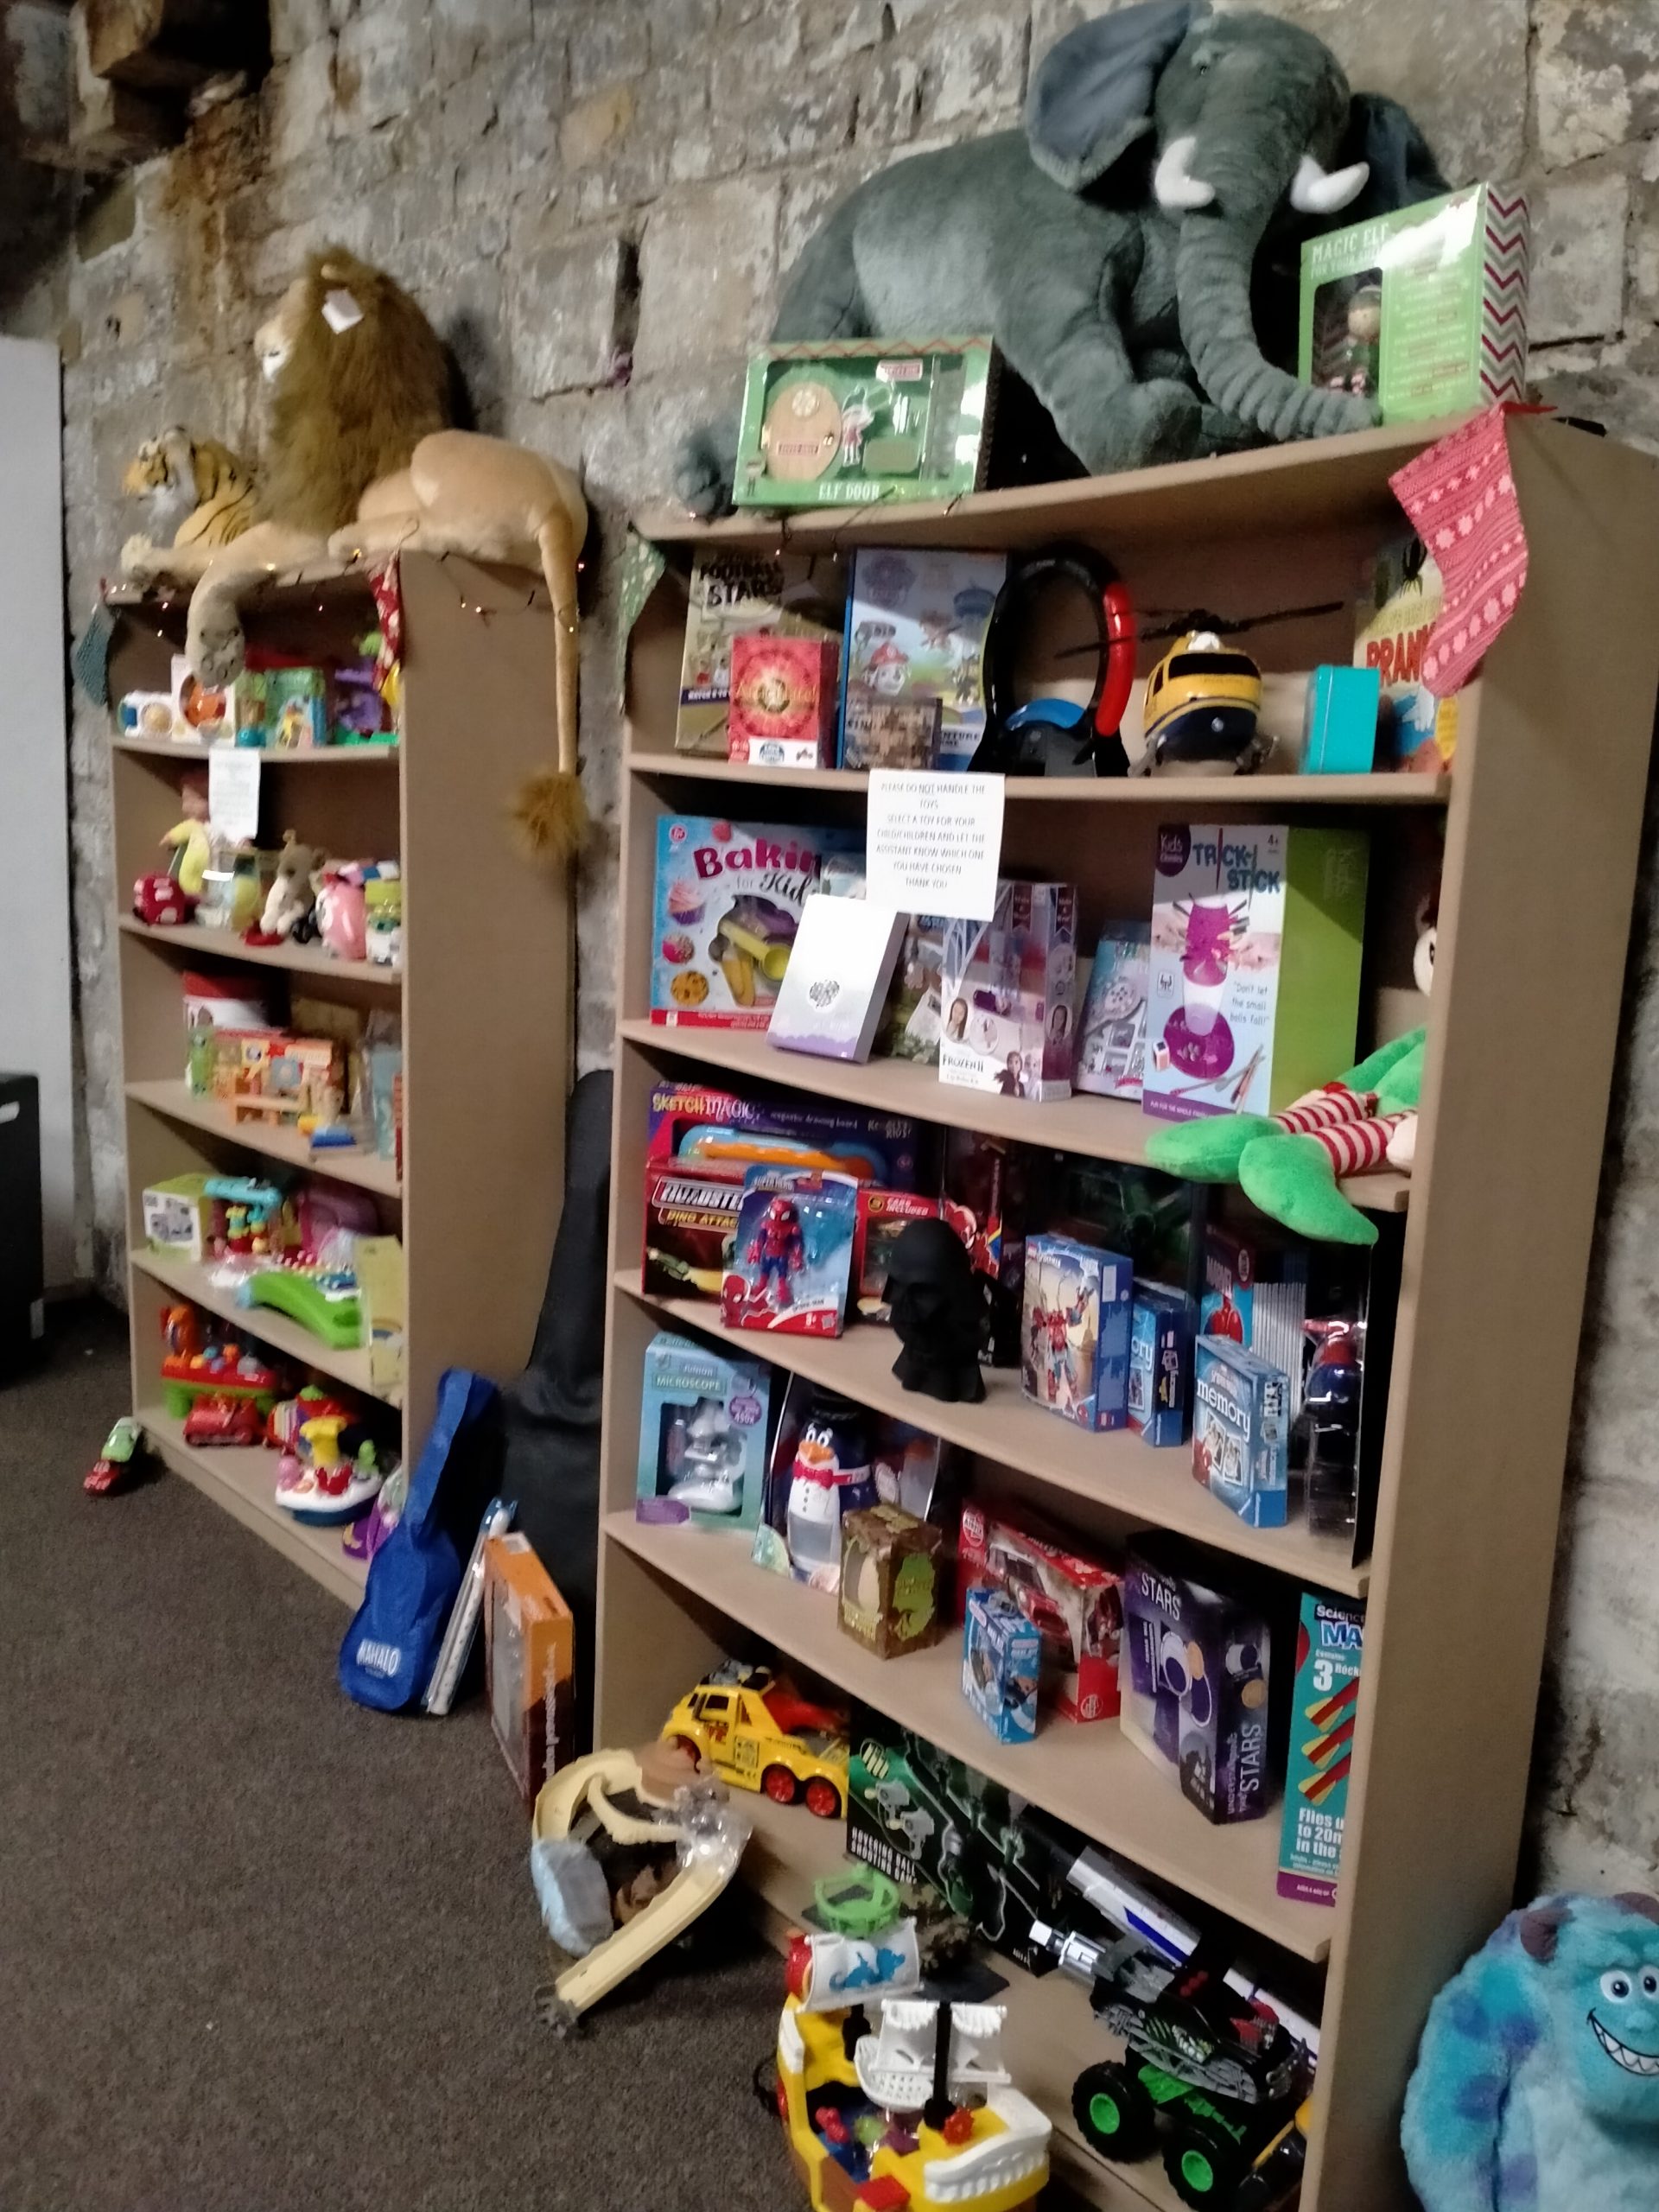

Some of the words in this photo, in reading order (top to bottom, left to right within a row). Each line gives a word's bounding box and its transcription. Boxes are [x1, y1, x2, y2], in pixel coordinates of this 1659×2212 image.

[1312, 232, 1358, 264] MAGIC
[1363, 222, 1389, 248] ELF
[818, 481, 842, 500] ELF
[845, 480, 880, 501] DOOR
[706, 577, 782, 607] STARS
[880, 782, 904, 792] PLEASE
[906, 784, 918, 793] DO
[918, 785, 935, 795] NOT
[937, 785, 969, 795] HANDLE
[972, 785, 986, 795] THE
[919, 800, 939, 810] TOYS
[887, 815, 911, 823] SELECT
[912, 815, 918, 823] A
[919, 815, 935, 824] TOY
[936, 816, 952, 825] FOR
[955, 817, 976, 826] YOUR
[877, 829, 936, 842] CHILD/CHILDREN
[938, 831, 955, 842] AND
[957, 832, 969, 843] LET
[971, 833, 985, 843] THE
[876, 846, 912, 856] ASSISTANT
[912, 847, 938, 858] KNOW
[940, 849, 967, 859] WHICH
[968, 850, 984, 861] ONE
[893, 861, 908, 870] YOU
[909, 862, 929, 873] HAVE
[931, 864, 962, 874] CHOSEN
[736, 875, 754, 889] for
[906, 877, 930, 887] THANK
[931, 879, 948, 889] YOU
[1227, 868, 1281, 895] STICK
[1257, 985, 1268, 995] let
[1232, 996, 1243, 1008] the
[1246, 1001, 1266, 1011] small
[1230, 1012, 1247, 1024] balls
[943, 1053, 976, 1070] FROZEN
[652, 1092, 706, 1116] SKETCH
[804, 1114, 836, 1128] drawing
[836, 1119, 858, 1130] board
[666, 1210, 696, 1226] DINO
[886, 1204, 930, 1217] INCLUDED
[683, 1364, 714, 1376] JUNIOR
[656, 1376, 721, 1391] MICROSCOPE
[1197, 1379, 1251, 1443] memory
[1141, 1573, 1182, 1621] STARS
[356, 1638, 402, 1677] MAHALO
[1313, 1659, 1332, 1691] 3
[1240, 1724, 1261, 1791] STARS
[1299, 1807, 1332, 1827] Flies
[1298, 1822, 1313, 1839] to
[851, 1826, 893, 1864] HOVERING
[895, 1853, 916, 1878] BALL
[1296, 1837, 1311, 1853] in
[1313, 1841, 1337, 1859] the
[850, 1839, 892, 1876] SHOOTING
